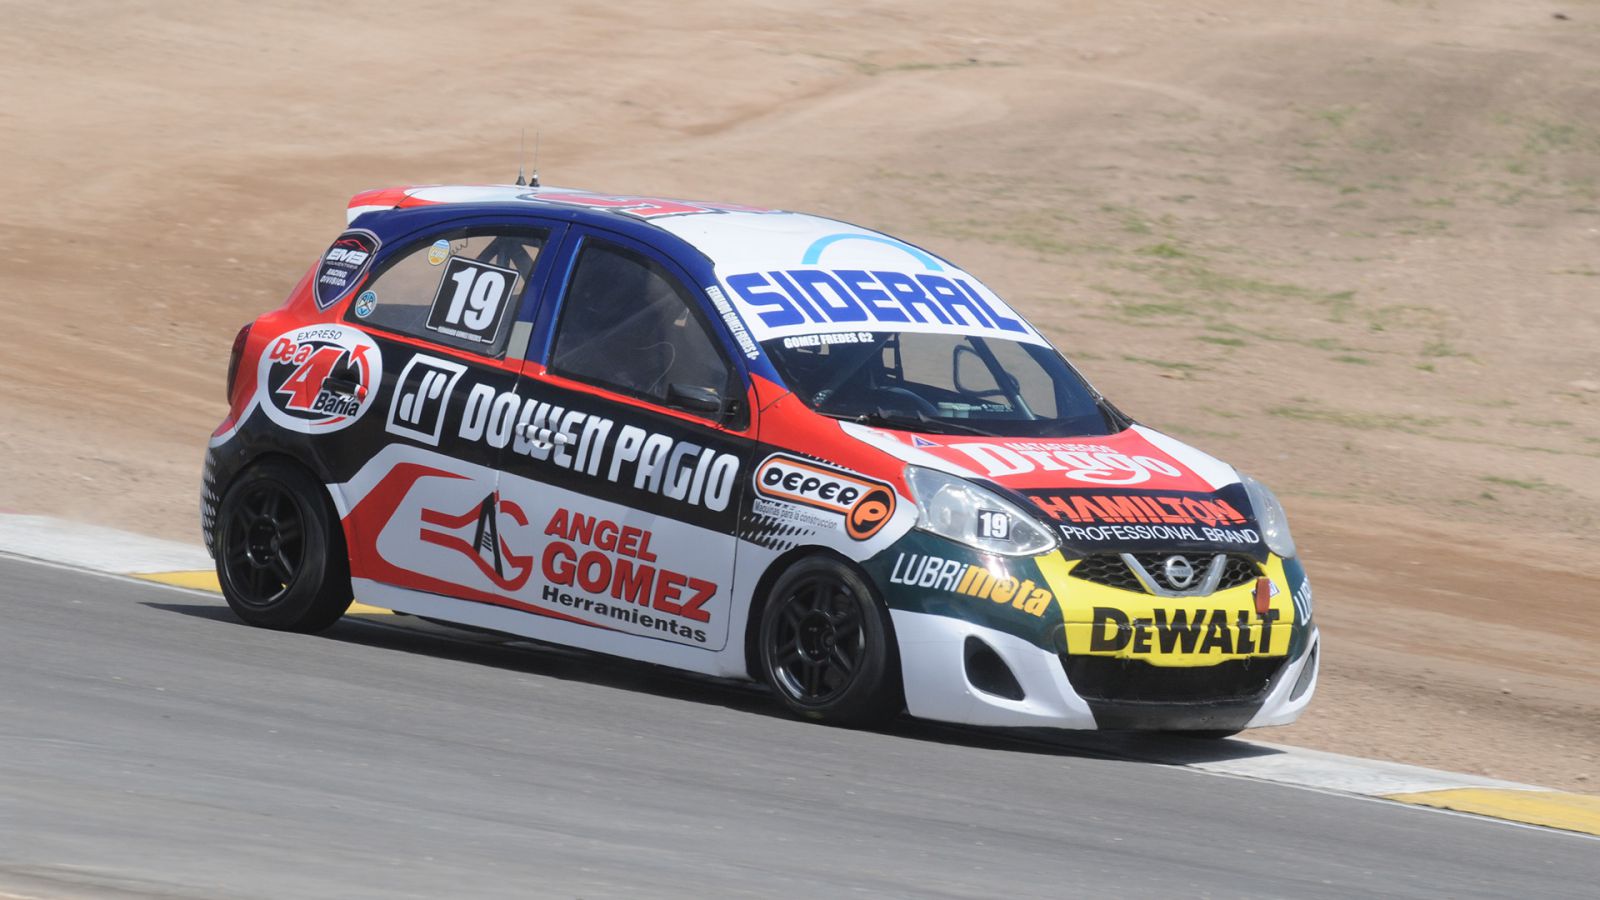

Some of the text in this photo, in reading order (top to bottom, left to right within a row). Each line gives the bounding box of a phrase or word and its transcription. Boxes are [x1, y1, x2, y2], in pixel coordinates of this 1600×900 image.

[445, 267, 506, 331] 19
[726, 270, 1030, 335] SIDERAL
[297, 329, 343, 341] EXPRESO
[783, 331, 875, 349] GOMEZ FREDES C2
[607, 424, 740, 512] PAGIO
[948, 442, 1182, 485] Drago
[763, 467, 859, 505] DEPER
[980, 511, 1008, 538] 19
[1028, 494, 1248, 528] HAMILTON
[544, 507, 658, 563] ANGEL
[1059, 524, 1260, 544] PROFESSIONAL BRAND
[541, 541, 718, 623] GOMEZ
[542, 585, 707, 643] Herramientas
